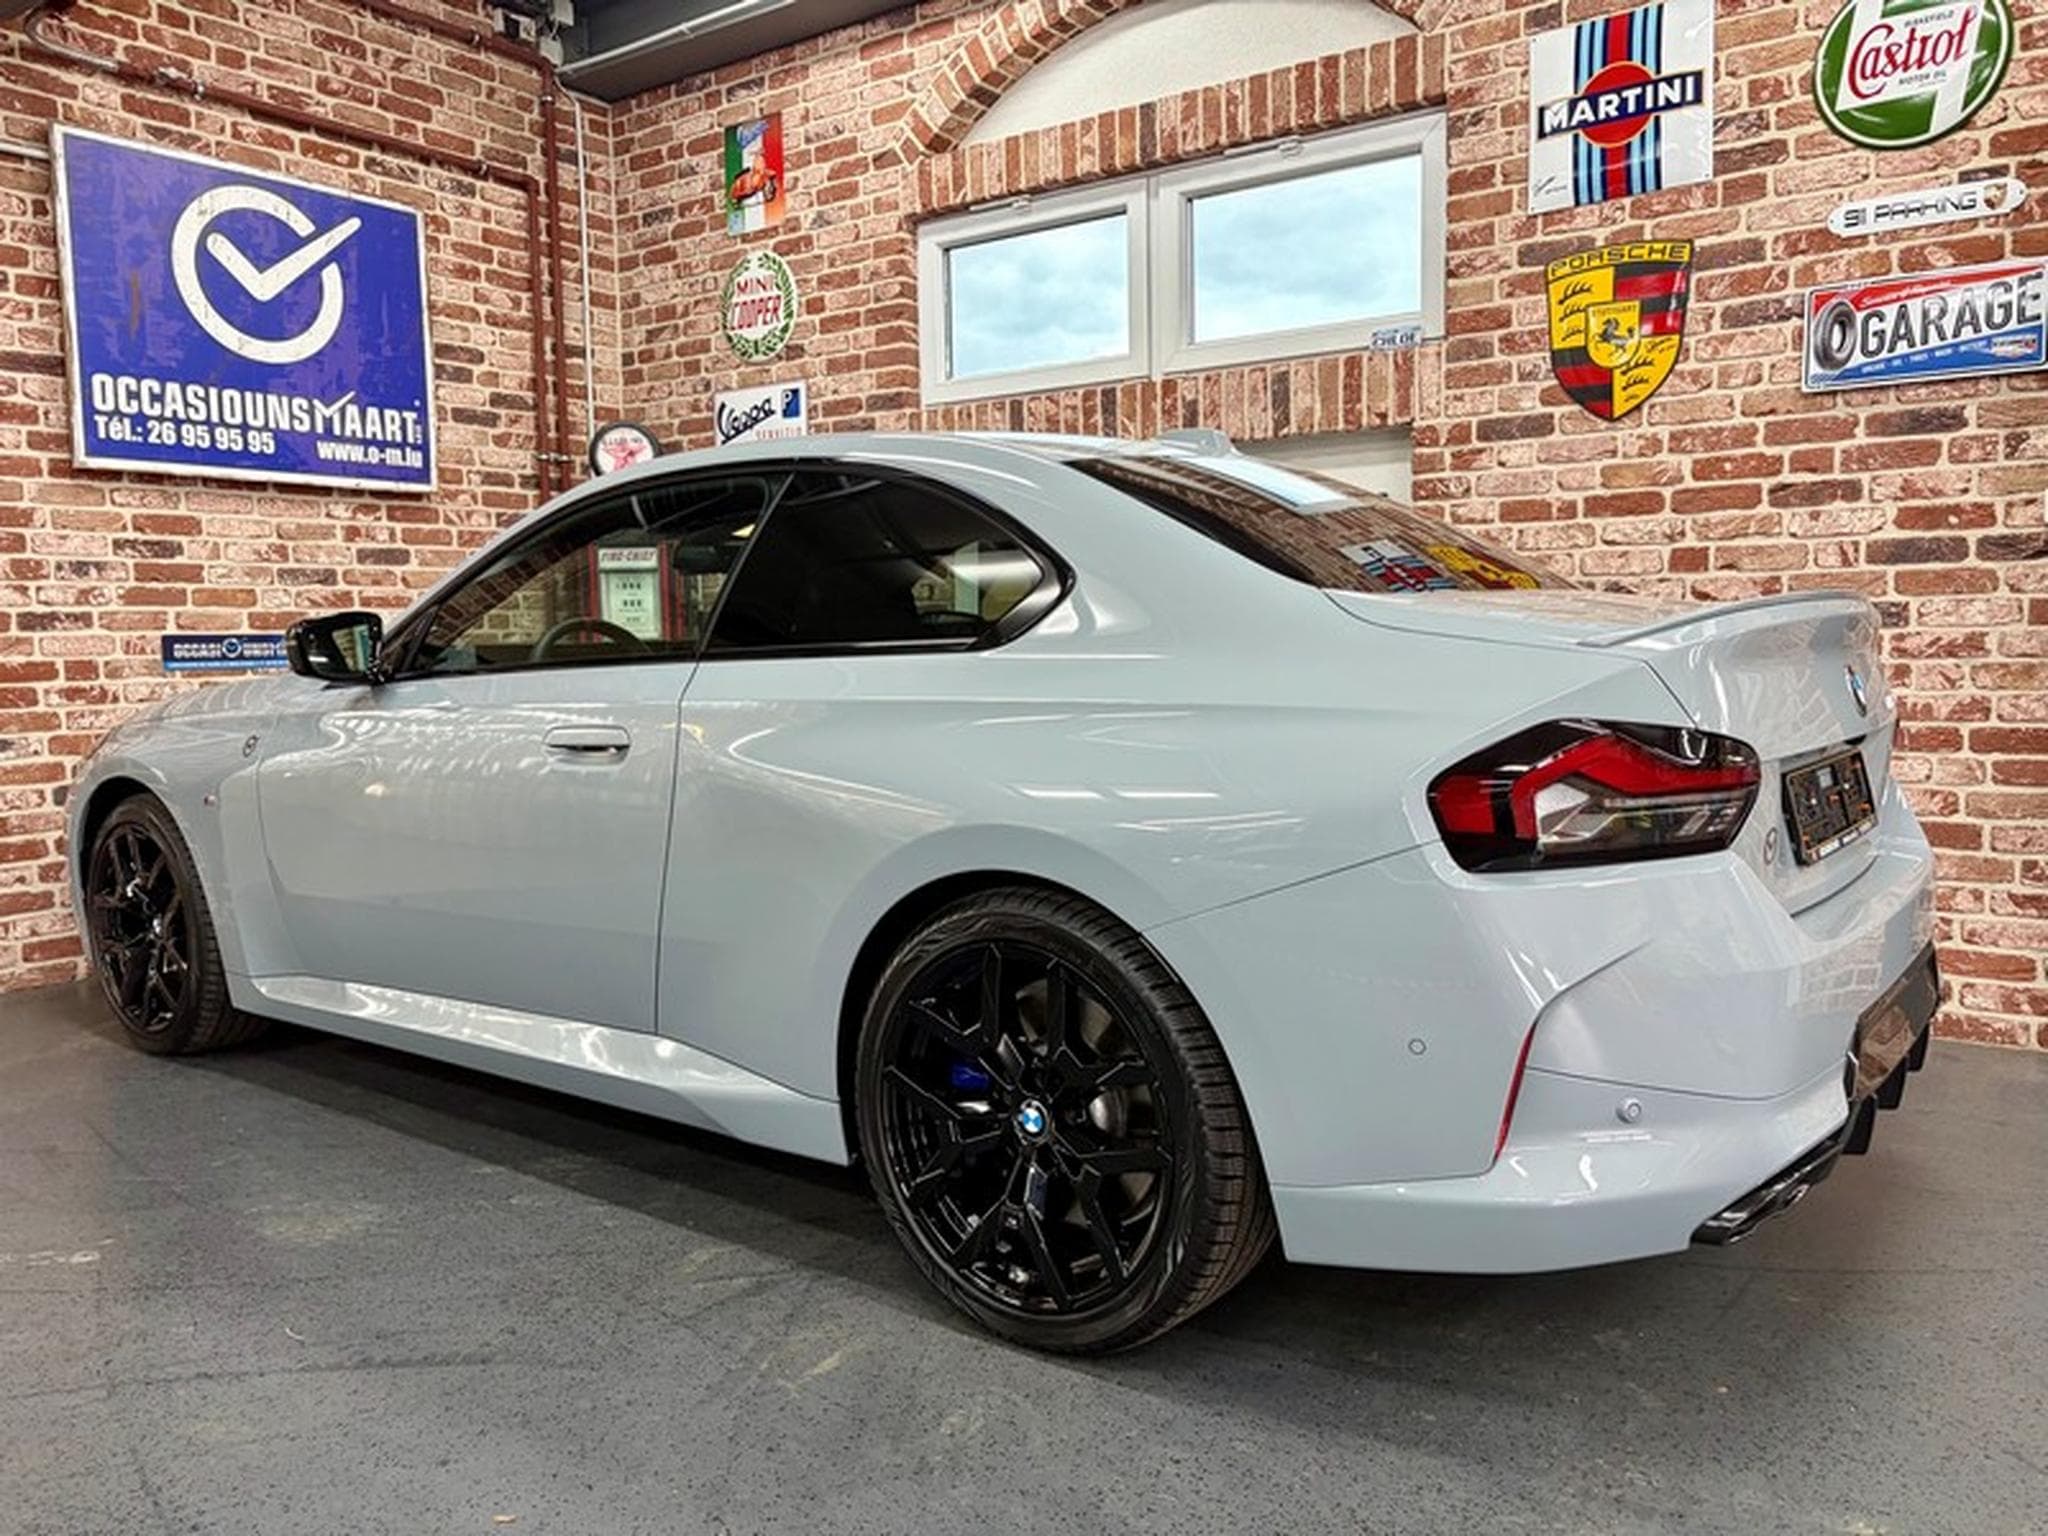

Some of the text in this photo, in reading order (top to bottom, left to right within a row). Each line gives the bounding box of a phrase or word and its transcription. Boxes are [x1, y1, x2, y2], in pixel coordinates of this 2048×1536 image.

[1847, 4, 1978, 100] Castrol
[1899, 73, 1930, 86] MOTOR
[1543, 75, 1695, 134] MARTINI
[1874, 191, 1978, 223] PARKING
[1550, 243, 1689, 278] PORSCHE
[735, 273, 775, 297] MINI
[730, 294, 782, 331] COOPER
[1860, 271, 2044, 359] GARAGE
[94, 414, 276, 454] Tél.: 26 95 95 95
[717, 397, 776, 446] Vespa
[316, 440, 423, 469] www.o-m.lu
